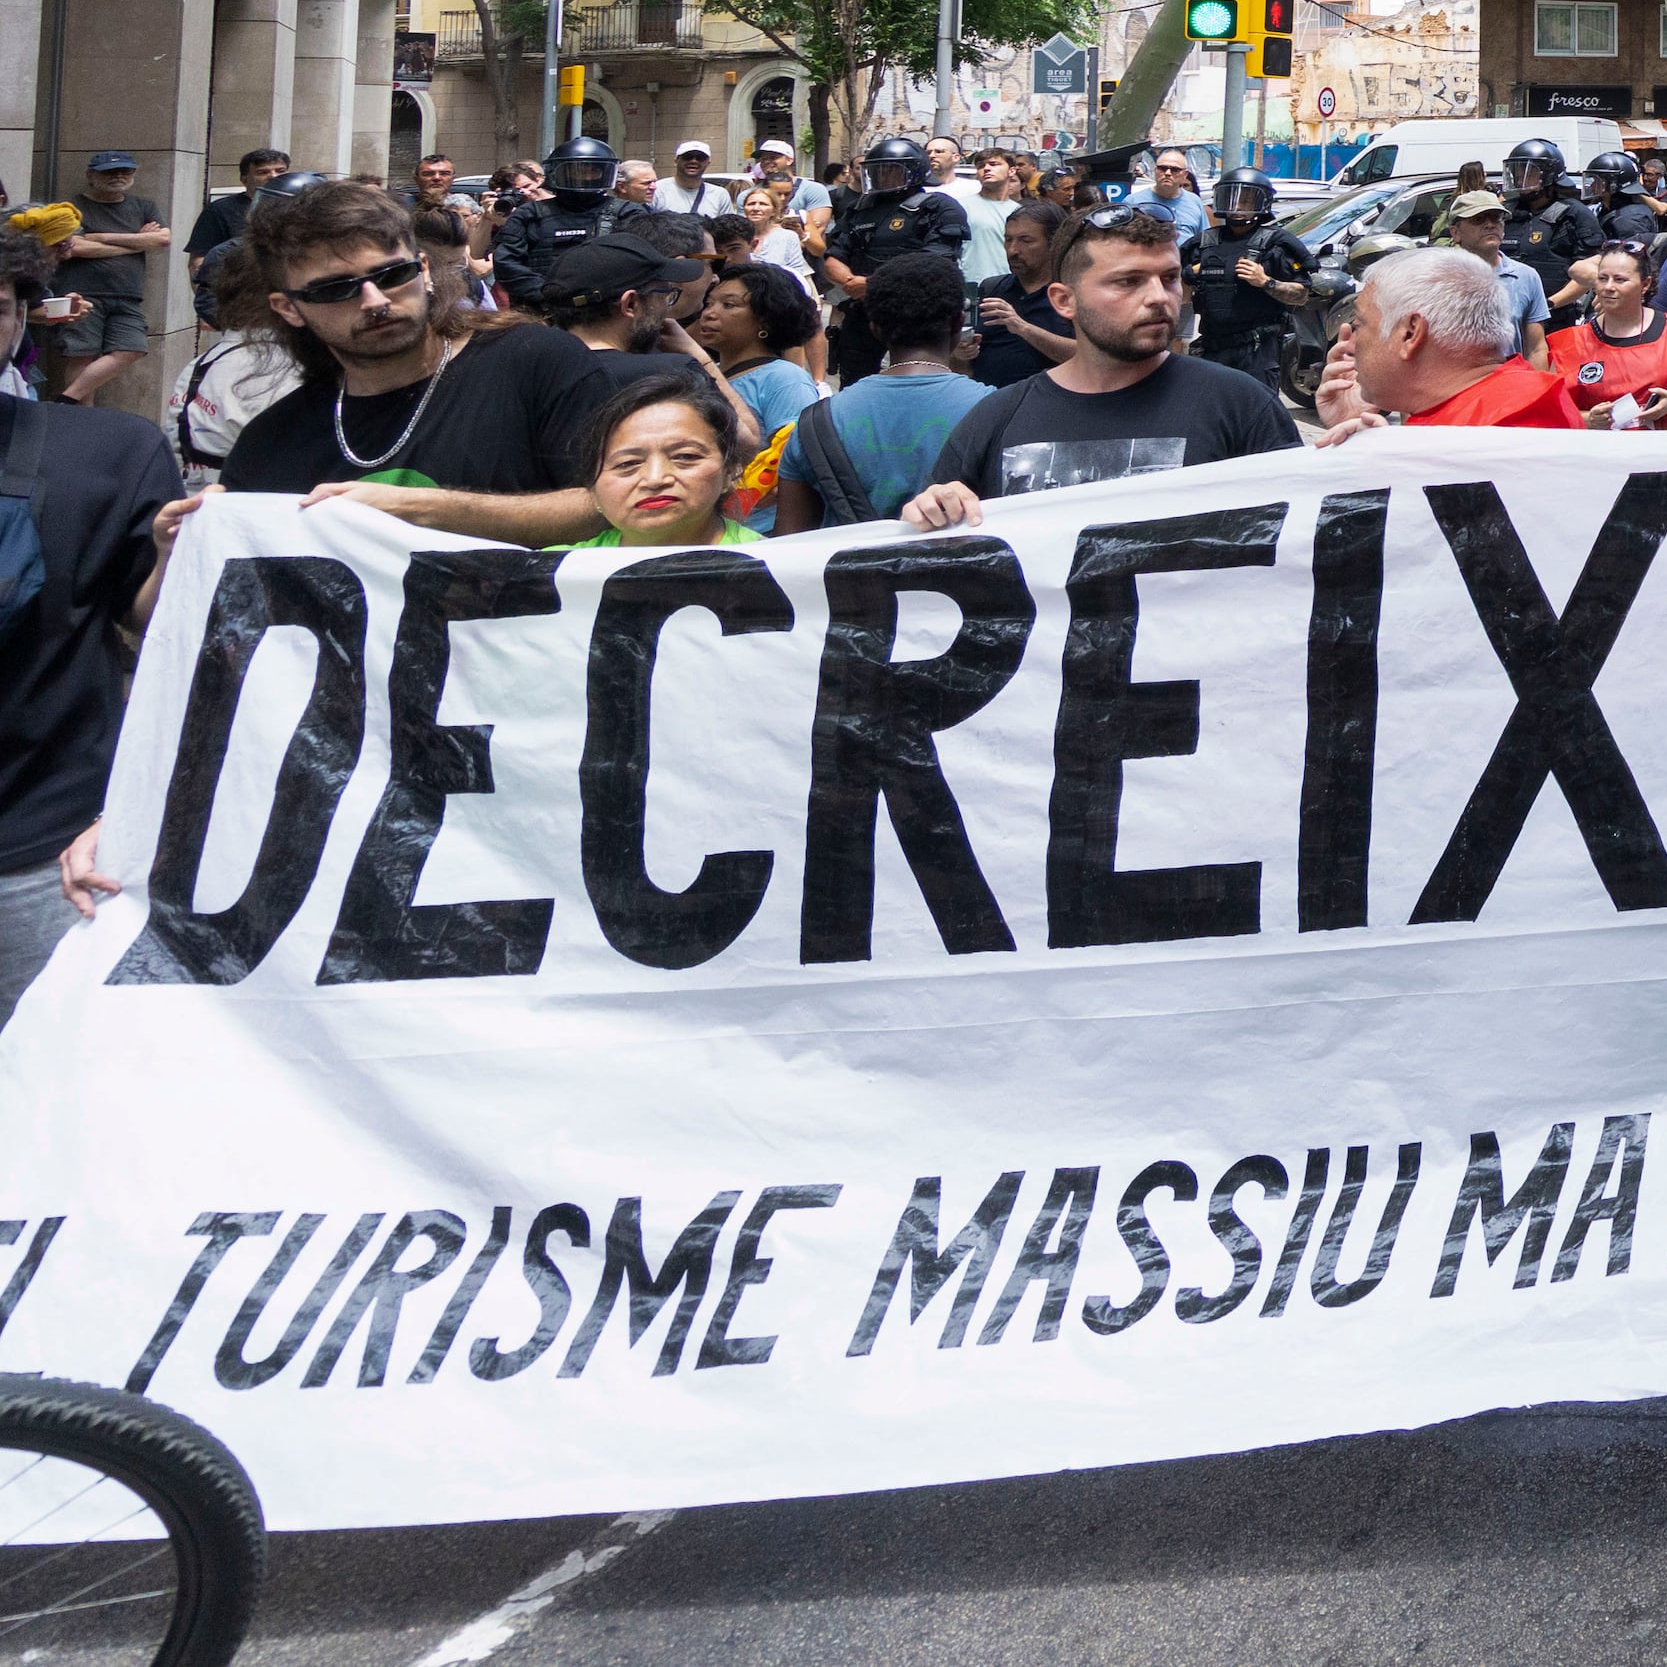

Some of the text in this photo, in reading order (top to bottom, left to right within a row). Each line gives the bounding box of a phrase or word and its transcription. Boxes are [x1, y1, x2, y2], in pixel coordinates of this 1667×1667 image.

[1322, 97, 1333, 107] 30
[1106, 184, 1122, 203] P
[124, 1200, 843, 1396] TURISME
[846, 1142, 1422, 1358] MASSIU
